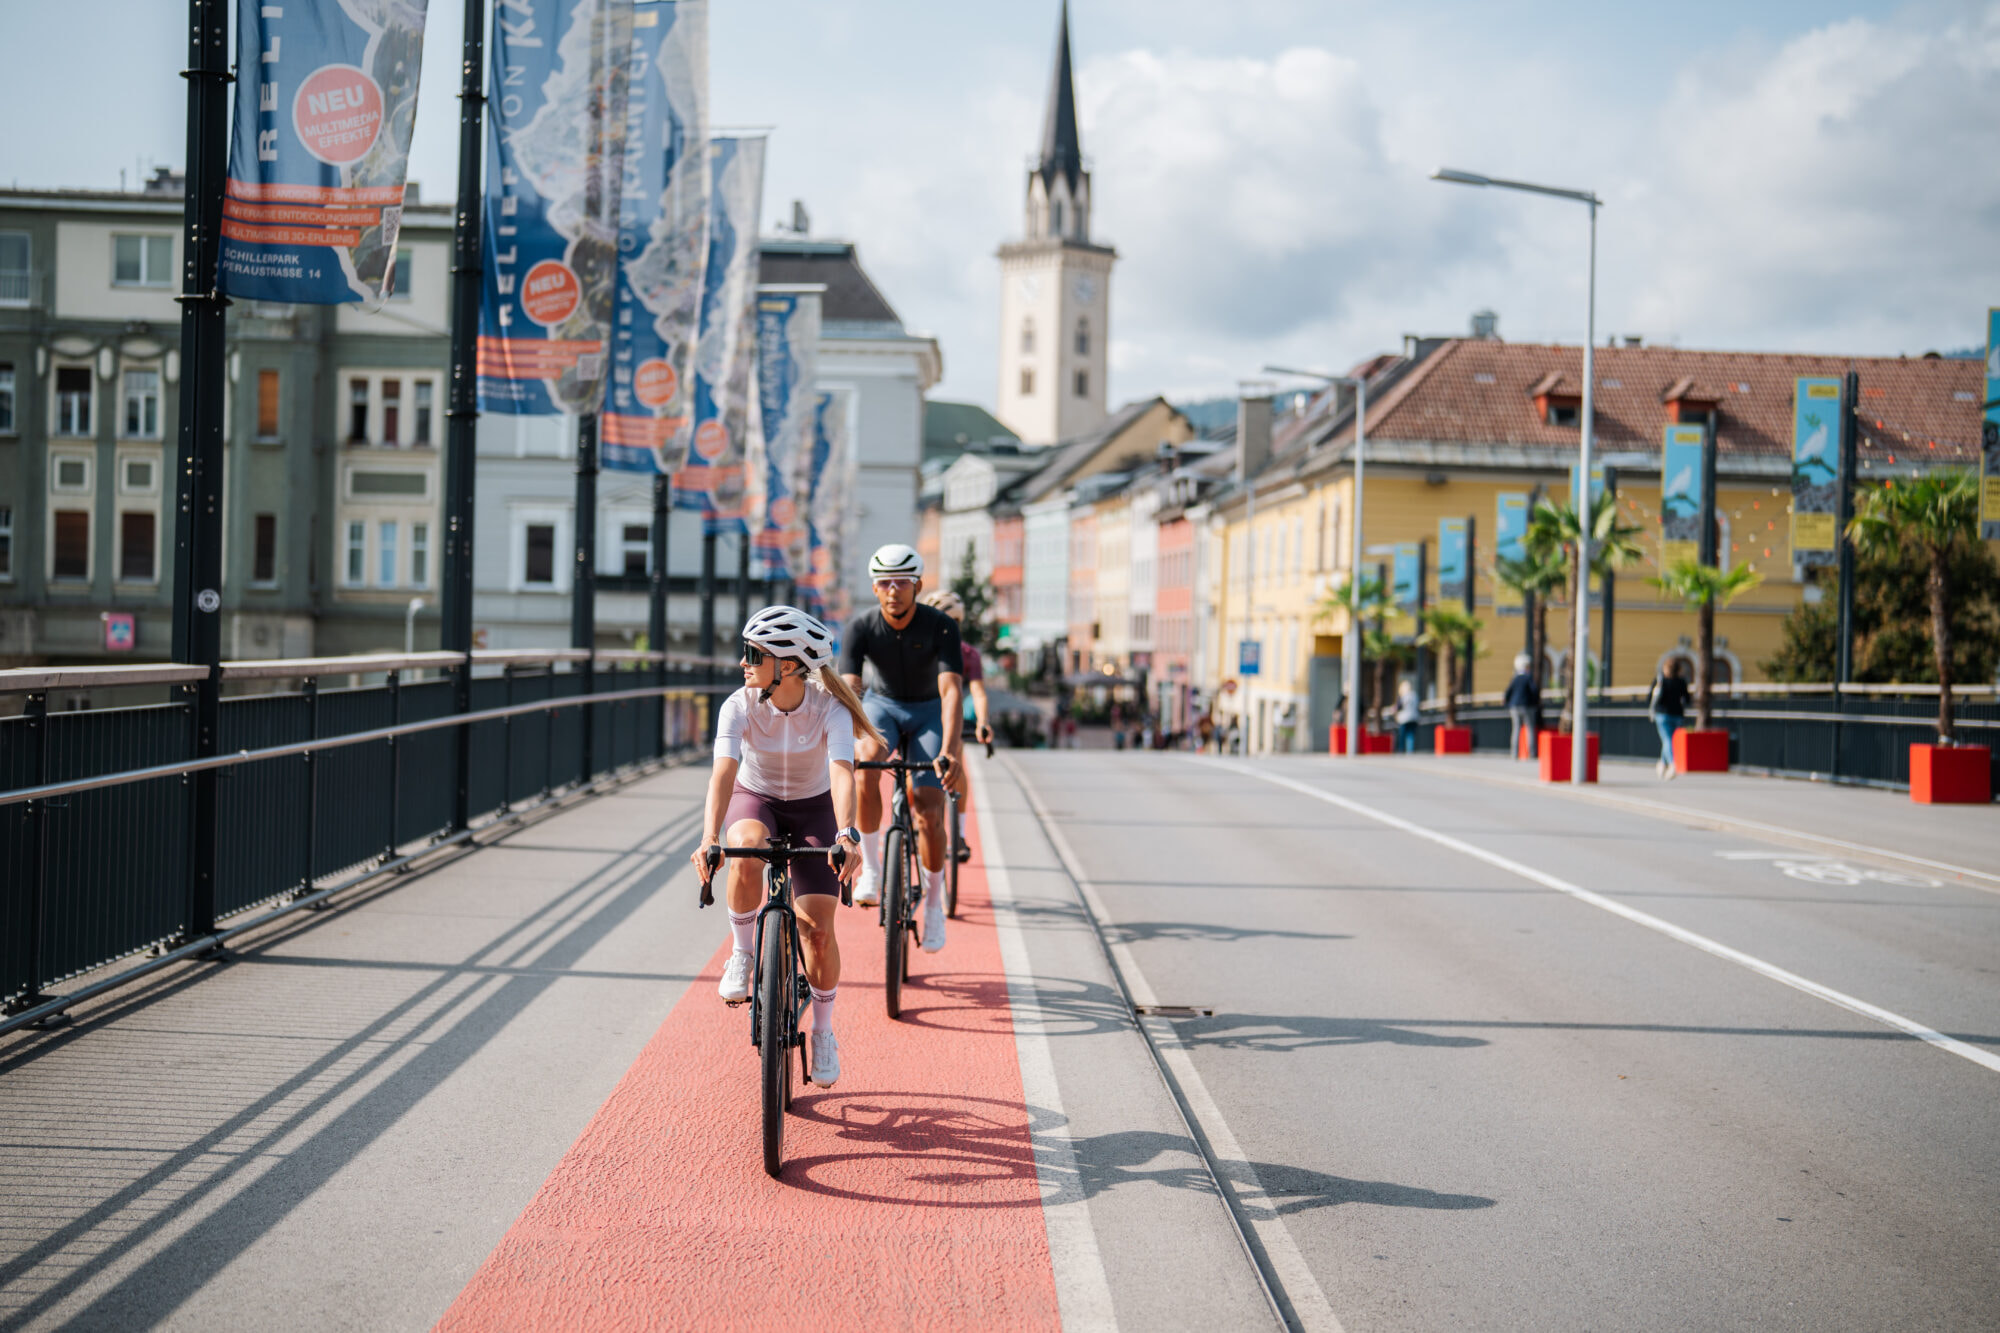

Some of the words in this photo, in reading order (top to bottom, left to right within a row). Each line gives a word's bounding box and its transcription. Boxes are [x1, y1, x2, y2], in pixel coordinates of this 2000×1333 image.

[259, 6, 283, 161] RELI
[306, 85, 364, 116] NEU
[304, 111, 379, 138] MULTIMEDIA
[318, 126, 371, 149] EFFEKTE
[224, 248, 300, 265] SCHILLERPARK
[222, 261, 303, 278] PERAUSTRASSE
[308, 269, 322, 279] 14
[529, 272, 565, 296] NEU
